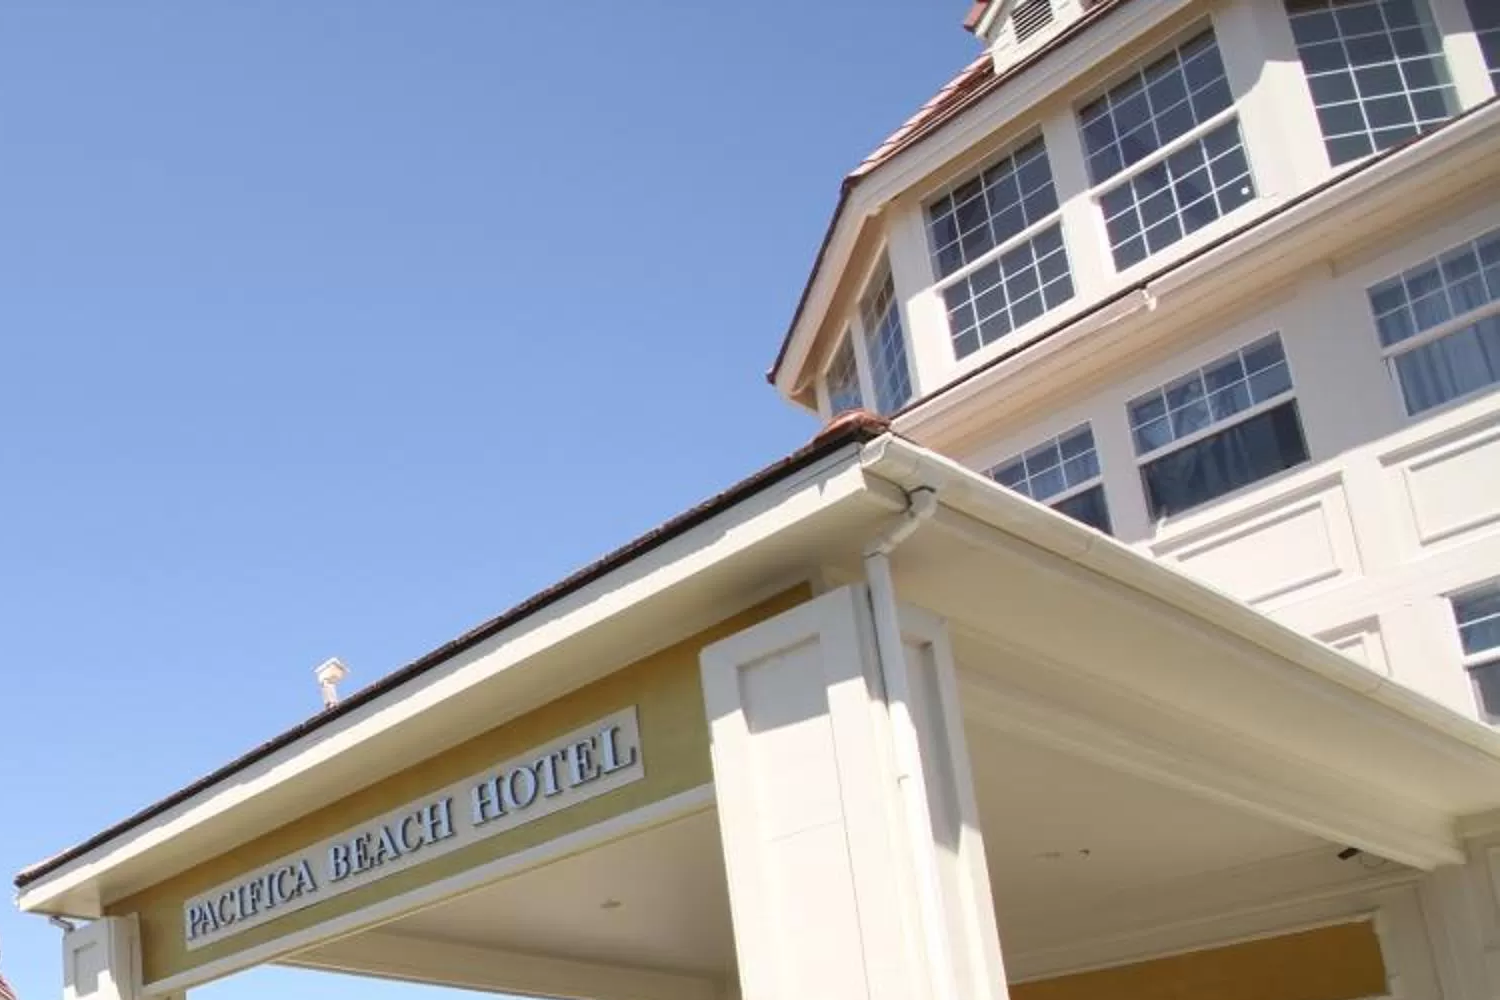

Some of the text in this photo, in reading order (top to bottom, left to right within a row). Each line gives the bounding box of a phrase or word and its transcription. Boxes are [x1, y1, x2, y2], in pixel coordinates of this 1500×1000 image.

[186, 727, 636, 940] PACIFICA BEACH HOTEL
